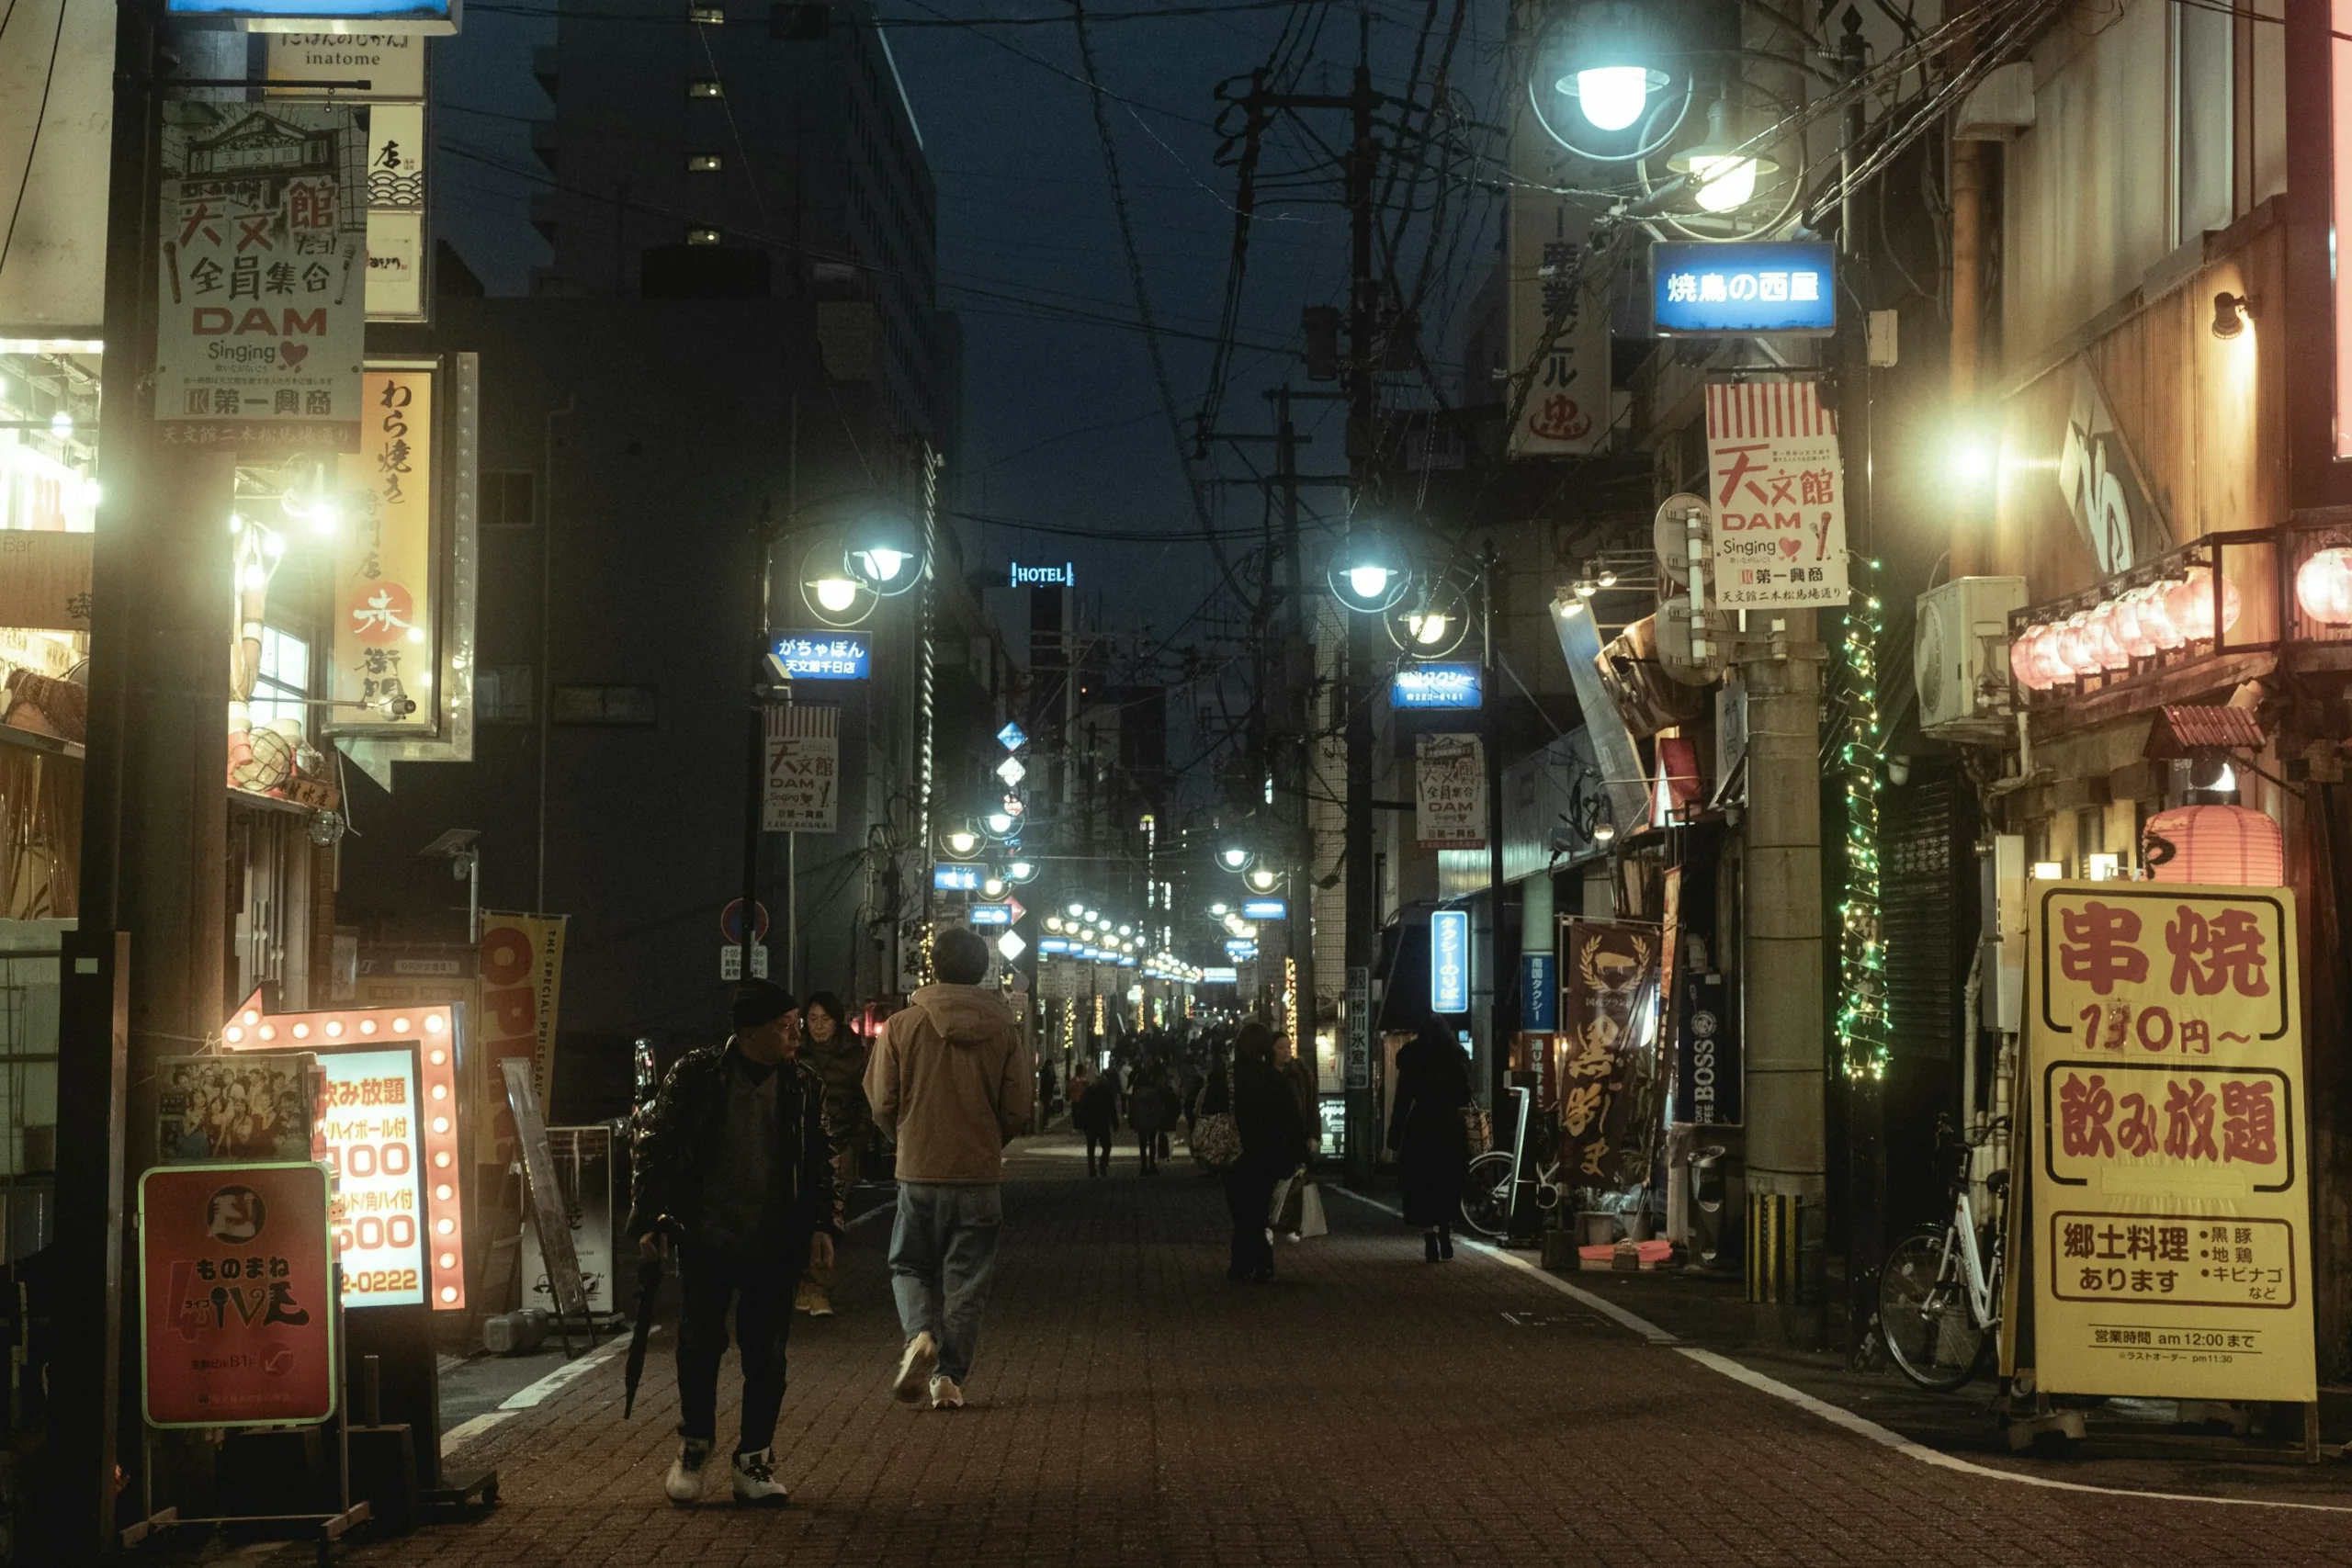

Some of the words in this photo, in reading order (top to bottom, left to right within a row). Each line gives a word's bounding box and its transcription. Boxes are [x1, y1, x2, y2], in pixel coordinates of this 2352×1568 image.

[306, 51, 380, 65] inatome
[188, 256, 331, 301] 全員集合
[1668, 272, 1820, 303] 焼鳥の西屋
[192, 307, 327, 337] DAM
[208, 341, 276, 363] Singing
[214, 389, 332, 416] 第一興商
[1714, 444, 1833, 509] 天文館
[1722, 512, 1802, 531] DAM
[1724, 537, 1776, 556] Singing
[1017, 567, 1066, 582] HOTEL
[1756, 567, 1823, 584] 第一興商
[1722, 587, 1841, 604] 天文館二本松馬場通り
[778, 638, 865, 659] がちゃぽん
[770, 778, 814, 789] DAM
[1427, 785, 1474, 801] 全員集合
[769, 792, 799, 803] Singing
[1429, 802, 1474, 813] DAM
[548, 930, 558, 954] THE
[2059, 900, 2270, 998] 串焼
[540, 961, 554, 1014] SPECIAL
[1530, 957, 1543, 1021] 南国タクシー
[1693, 1039, 1715, 1102] BOSS
[2059, 1073, 2278, 1166] 飲み放題
[2063, 1222, 2189, 1262] 郷土料理
[197, 1256, 290, 1280] ものまね
[2212, 1266, 2284, 1284] キビナゴ
[2079, 1267, 2179, 1293] あります
[2248, 1286, 2277, 1300] など
[2094, 1328, 2152, 1345] 営業時間
[2185, 1333, 2223, 1348] 12:00
[2227, 1334, 2255, 1348] まで
